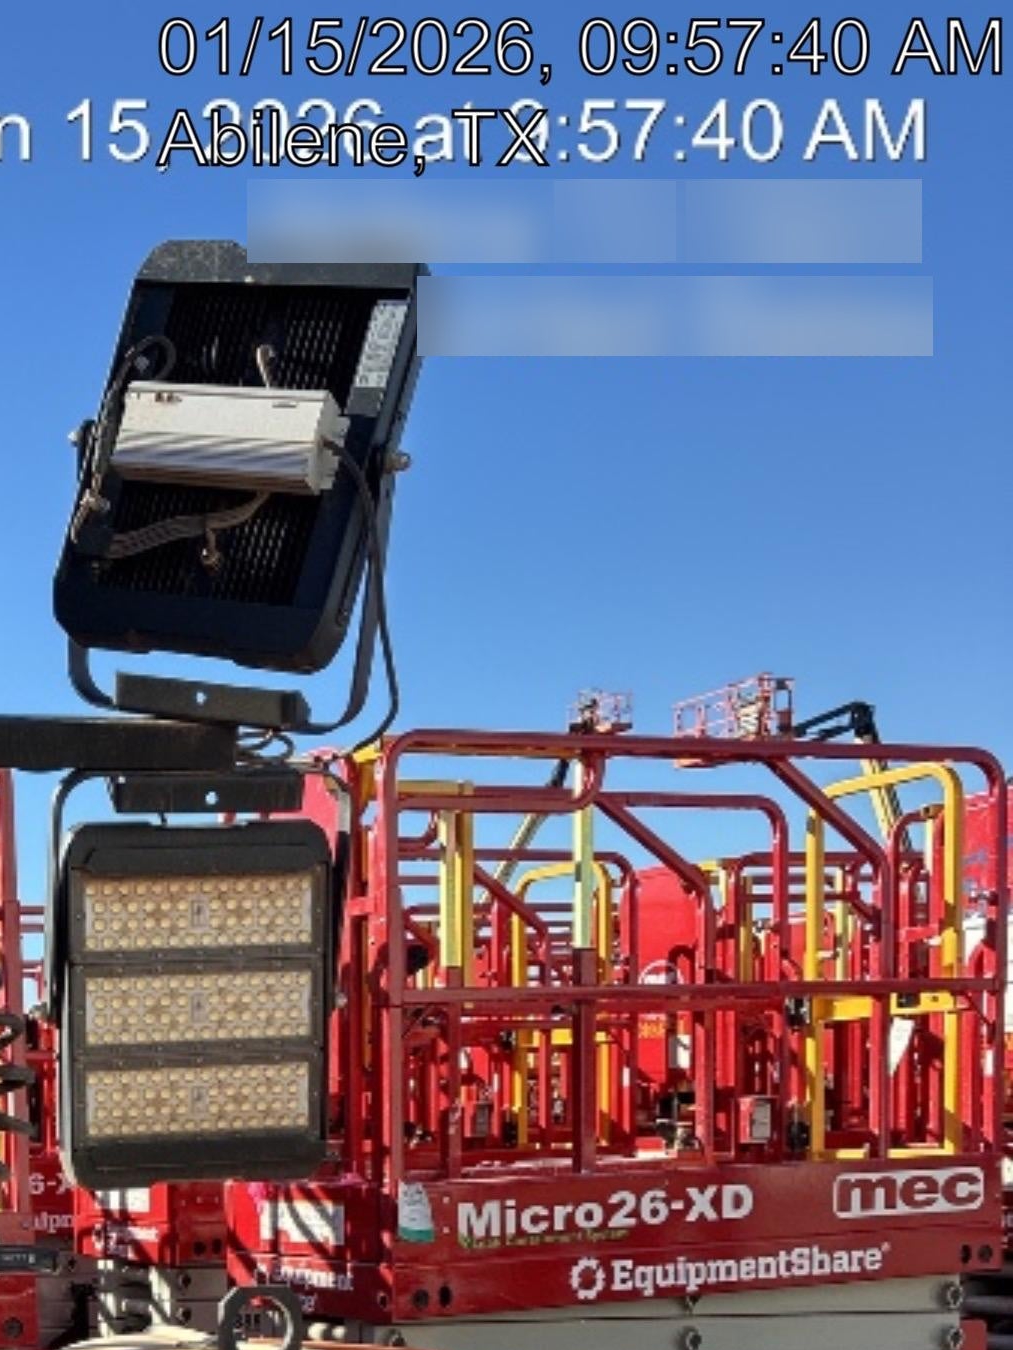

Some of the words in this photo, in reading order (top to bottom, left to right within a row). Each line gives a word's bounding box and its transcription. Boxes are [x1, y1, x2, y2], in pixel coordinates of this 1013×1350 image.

[457, 1184, 754, 1238] Micro26-XD
[836, 1172, 983, 1214] mec
[610, 1245, 885, 1297] EquipmentShare
